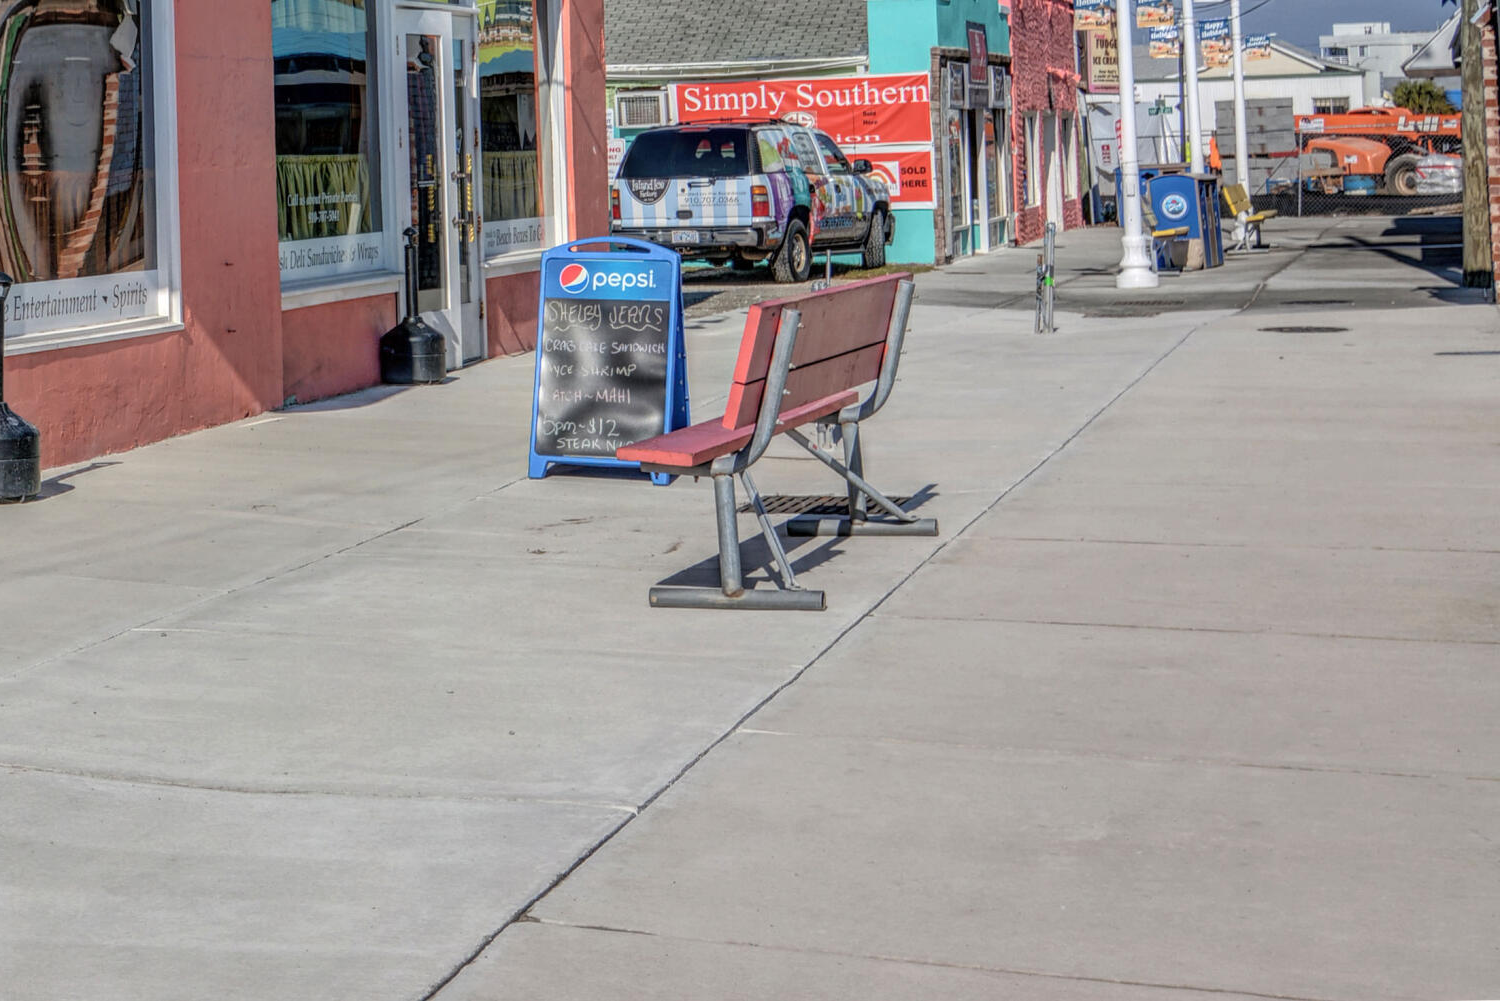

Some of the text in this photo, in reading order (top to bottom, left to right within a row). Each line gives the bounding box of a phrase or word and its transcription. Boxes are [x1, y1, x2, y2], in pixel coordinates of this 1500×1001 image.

[1204, 20, 1224, 30] Happy
[1102, 56, 1119, 65] CREA
[684, 80, 930, 116] Simply Southern
[836, 133, 881, 143] ion
[901, 166, 926, 174] SOLD
[900, 180, 927, 188] HERE
[290, 248, 306, 270] Deli
[307, 244, 346, 268] Sandwiche
[357, 242, 380, 265] Wraps
[593, 269, 654, 292] pepsi
[13, 288, 98, 322] Entertainment
[112, 281, 148, 316] Spirits
[548, 300, 602, 331] SHELBY
[545, 338, 576, 353] CRAB
[556, 437, 602, 451] STEAK
